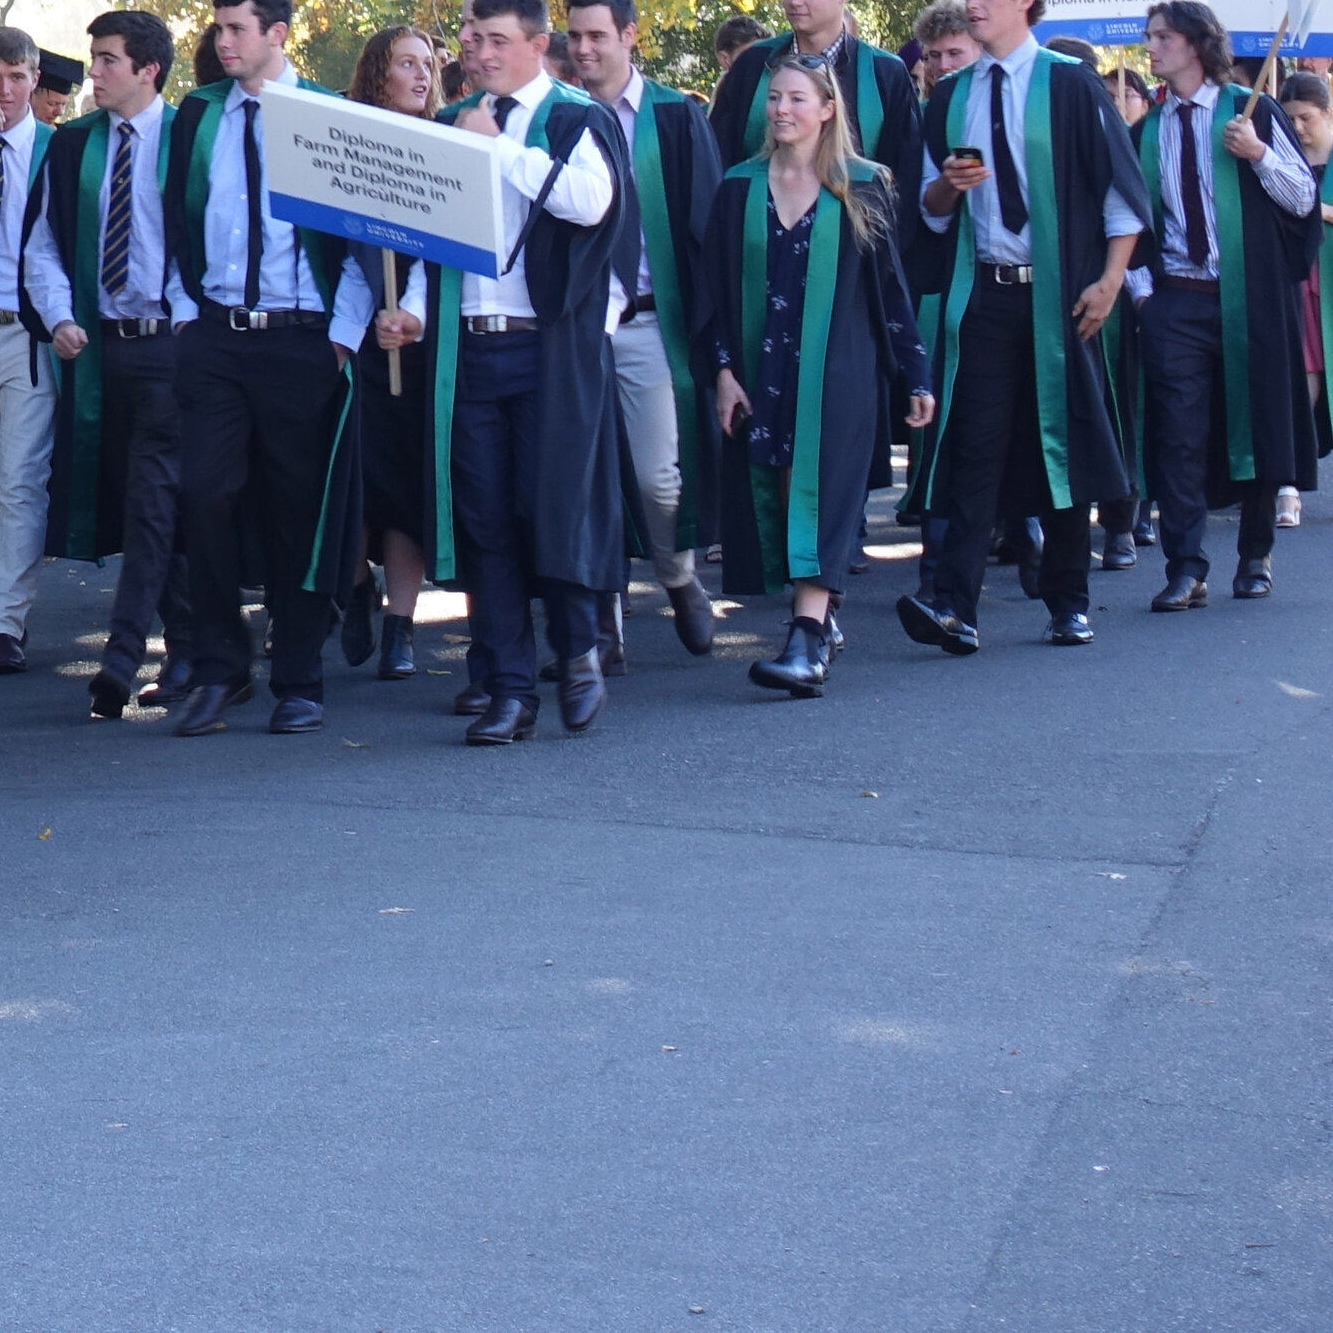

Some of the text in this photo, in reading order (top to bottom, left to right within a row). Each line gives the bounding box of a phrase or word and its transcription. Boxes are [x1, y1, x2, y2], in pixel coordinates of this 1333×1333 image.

[293, 134, 463, 192] Farm Management
[328, 127, 425, 165] Diploma in
[312, 156, 447, 203] and Diploma in
[331, 176, 432, 215] Agriculture
